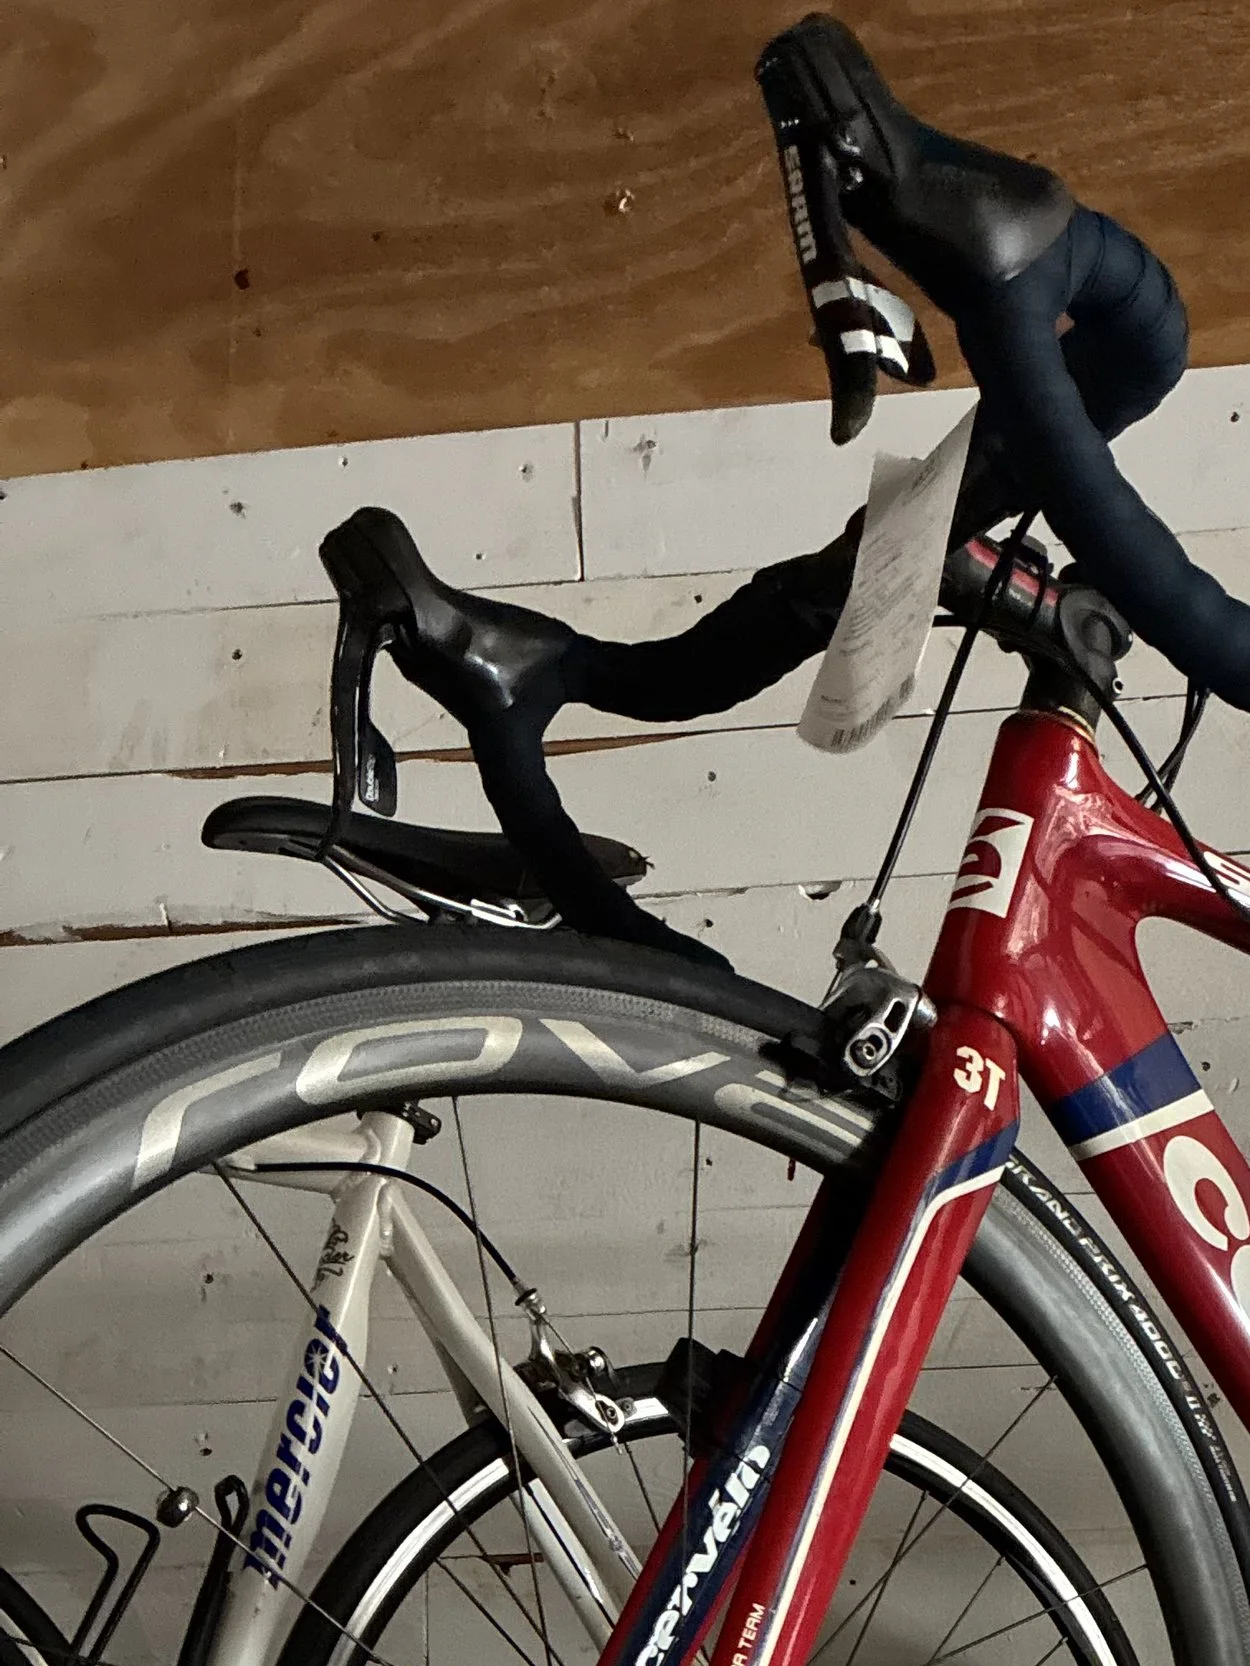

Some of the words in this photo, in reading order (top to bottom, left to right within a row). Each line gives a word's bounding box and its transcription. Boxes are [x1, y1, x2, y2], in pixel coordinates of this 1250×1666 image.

[132, 1015, 880, 1192] rova
[952, 1045, 1006, 1112] 3T
[243, 1304, 351, 1589] mercier
[737, 1602, 765, 1649] TEAM
